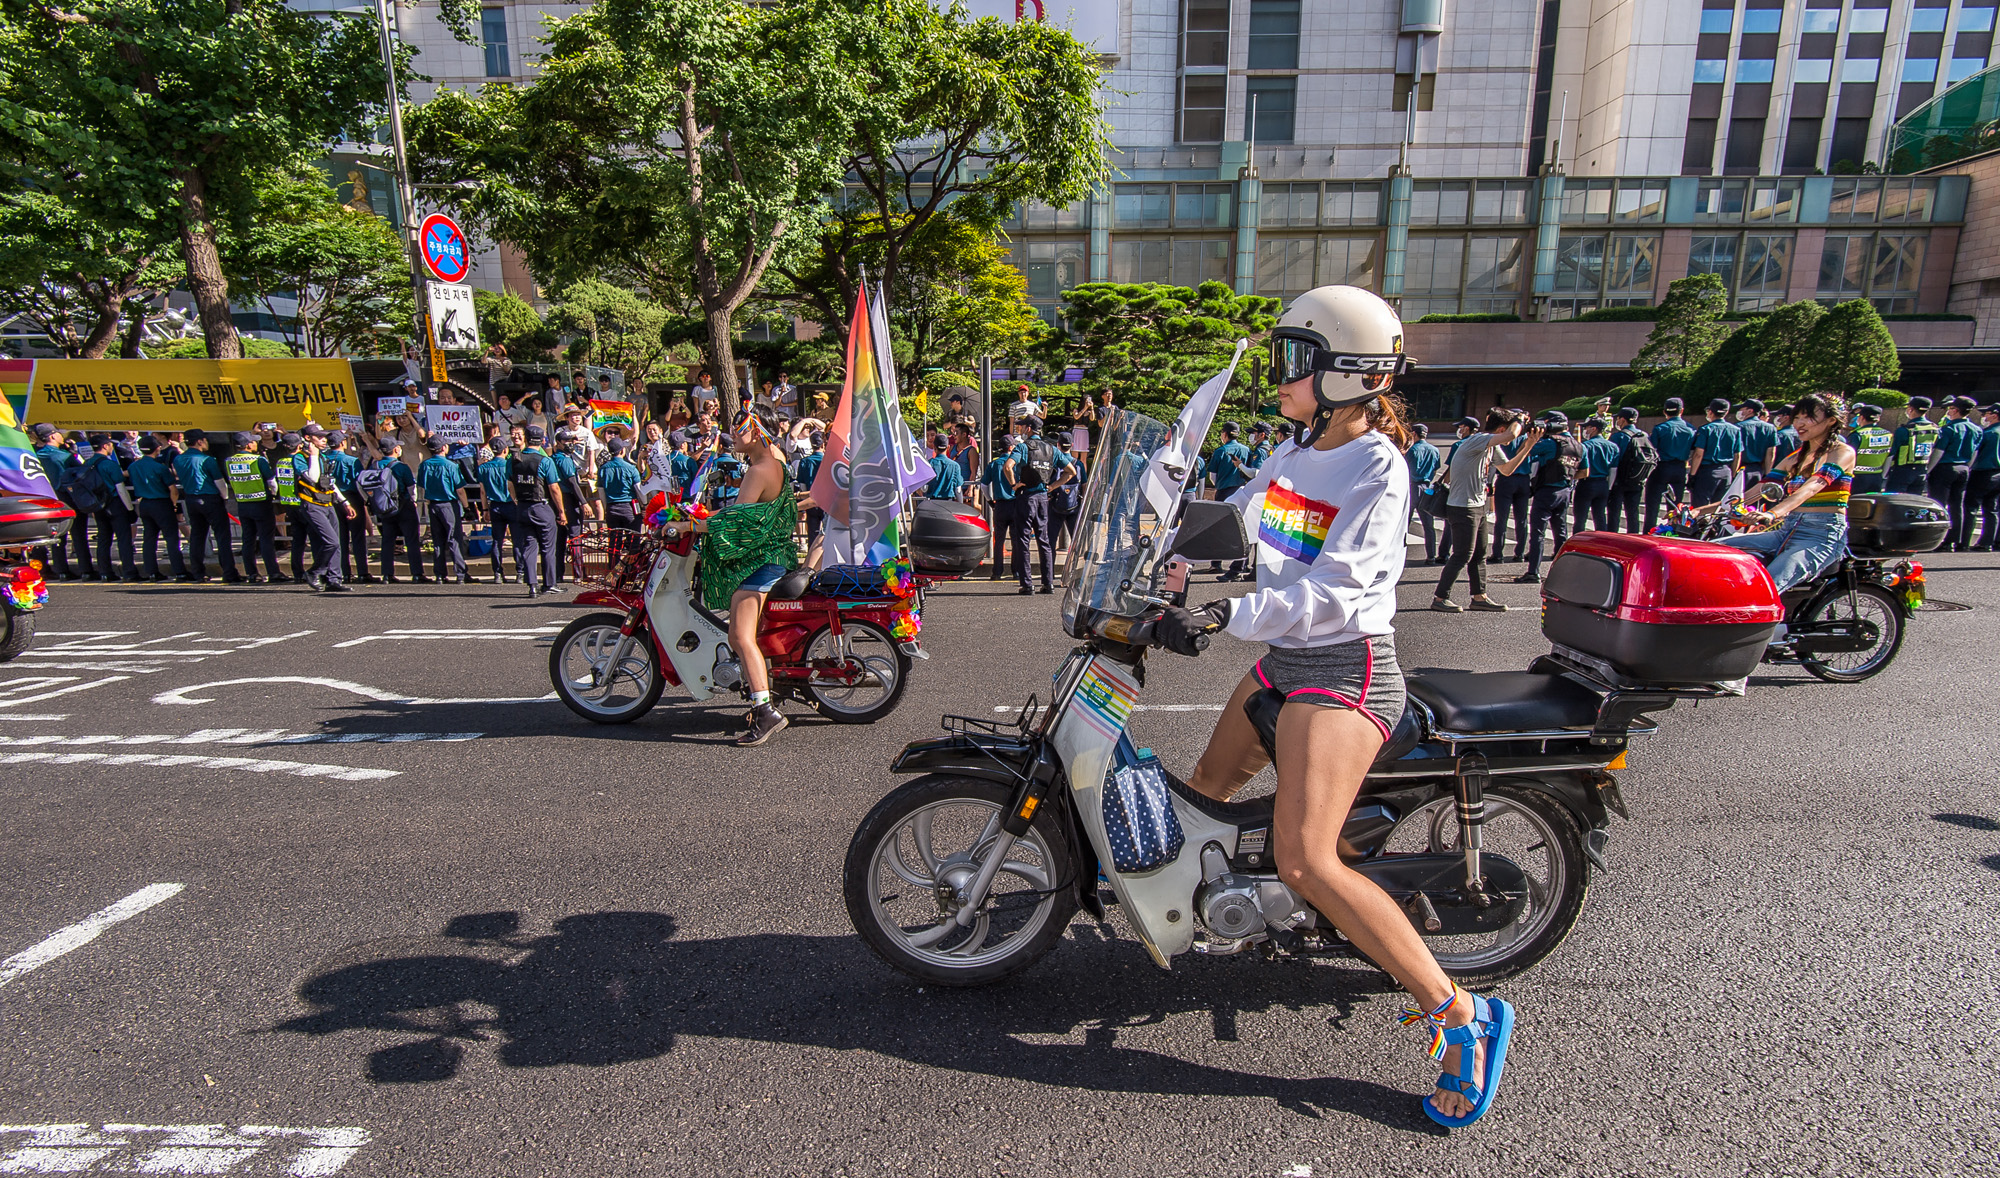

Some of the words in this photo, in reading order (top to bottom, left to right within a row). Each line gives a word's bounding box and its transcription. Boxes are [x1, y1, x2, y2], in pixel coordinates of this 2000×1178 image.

[429, 241, 462, 257] 주정차금지
[433, 287, 469, 302] 견인지역
[43, 383, 98, 405] 차별과
[100, 383, 155, 405] 혐오를
[156, 383, 195, 405] 넘어
[196, 383, 236, 405] 함께
[239, 383, 347, 405] 나아갑시다!
[442, 411, 468, 421] NO!!
[770, 602, 802, 610] MOTUL
